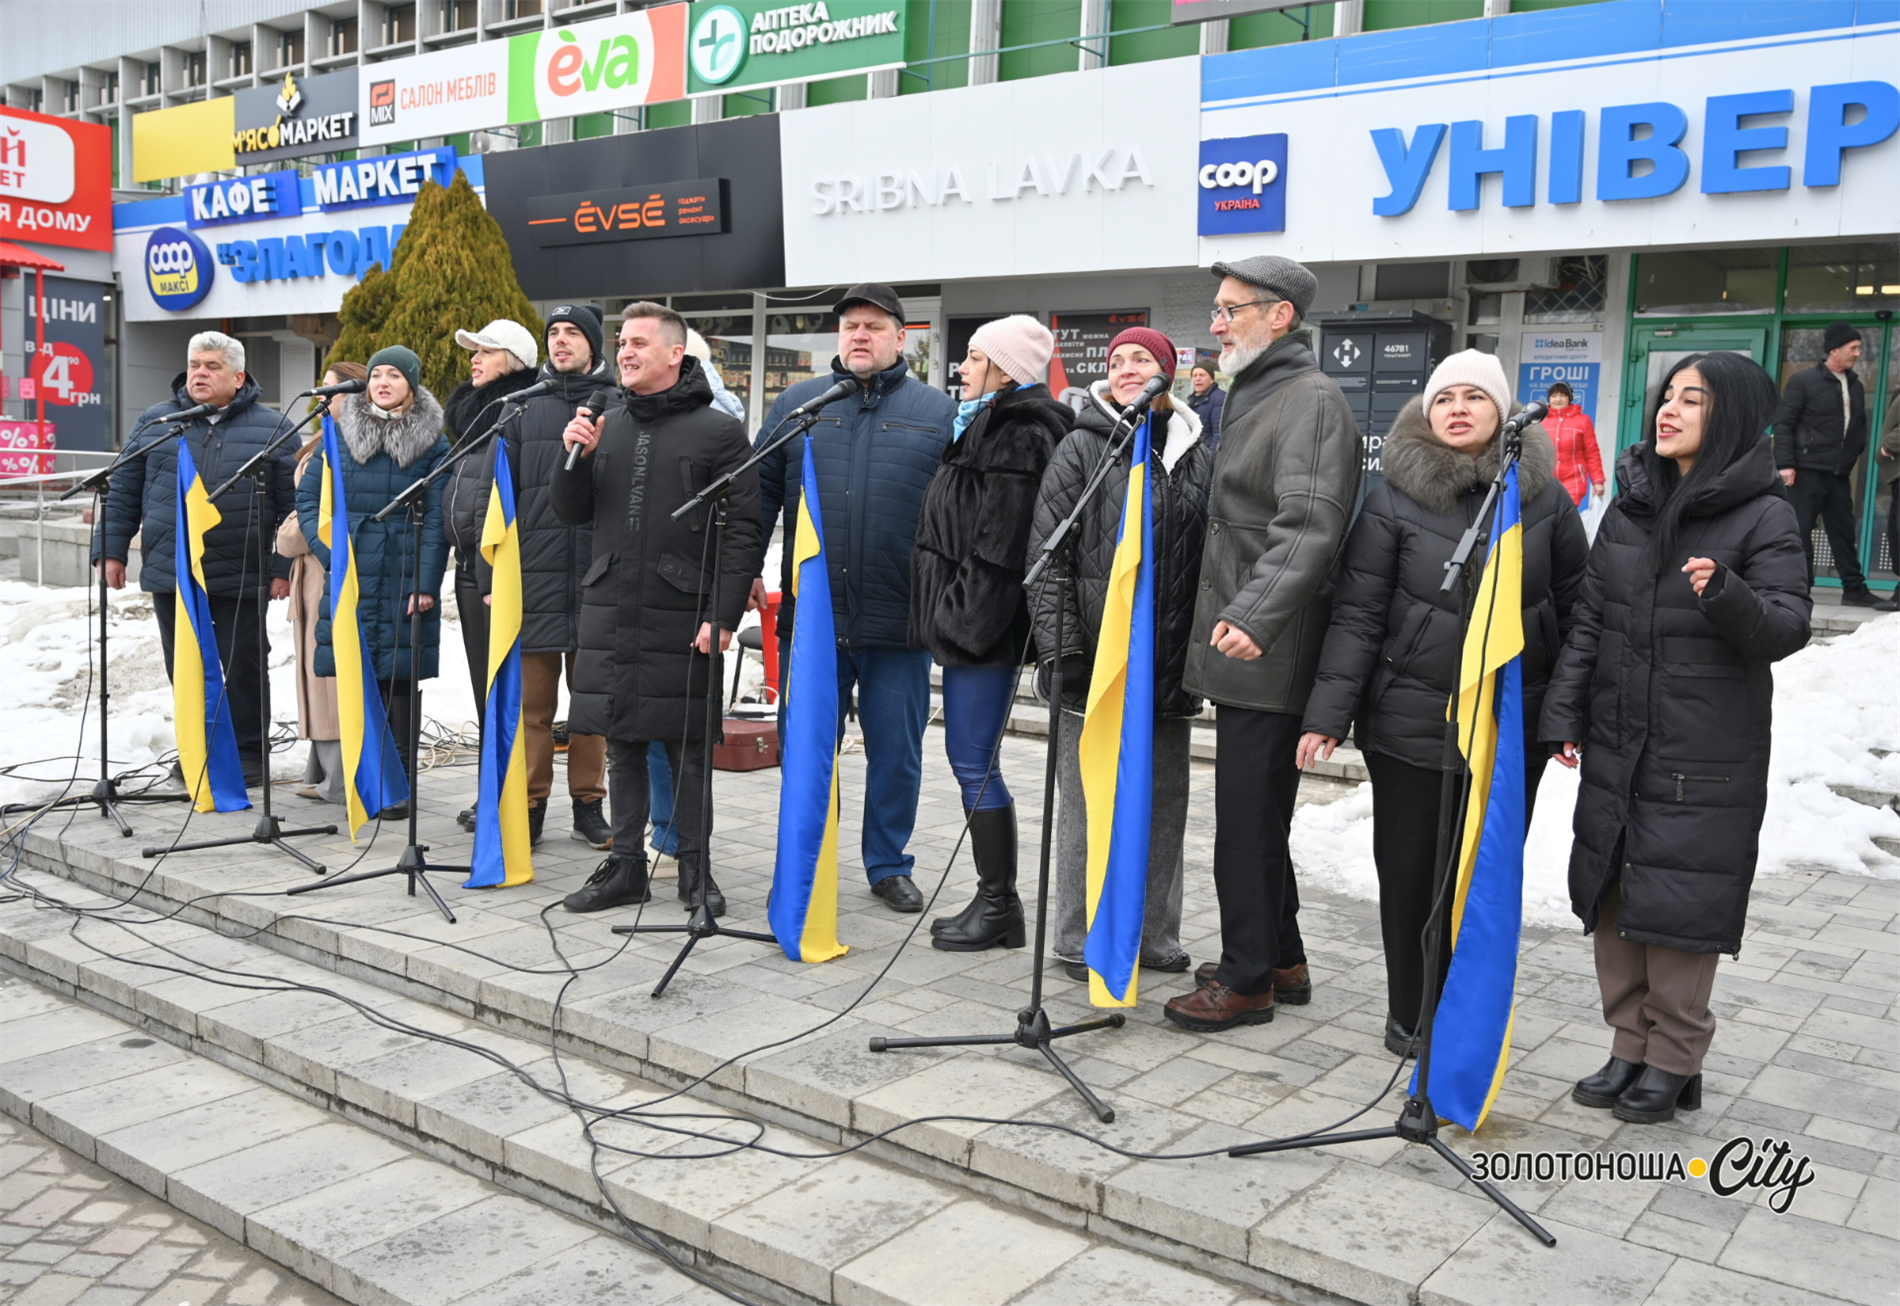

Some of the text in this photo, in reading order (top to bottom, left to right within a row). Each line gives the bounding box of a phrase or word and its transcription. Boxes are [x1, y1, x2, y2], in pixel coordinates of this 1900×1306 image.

[750, 1, 829, 33] АПТЕКА
[749, 11, 898, 55] ПОДОРОЖНИК
[400, 72, 496, 110] САЛОН МЕБЛІВ
[1369, 80, 1900, 217] УНІВЕР
[192, 153, 440, 221] КАФЕ МАРКЕТ
[810, 145, 1154, 216] SRIBNA LAVKA
[1214, 196, 1261, 212] УКРАЇНА
[17, 205, 92, 232] ДОМУ
[160, 279, 190, 294] МАКСІ
[1051, 328, 1080, 340] ТУТ
[25, 340, 54, 358] вд
[1384, 344, 1409, 352] 46781
[42, 355, 74, 399] 4
[1076, 361, 1108, 374] СКЛ
[1529, 366, 1589, 381] ГРОШІ
[70, 391, 101, 408] грн
